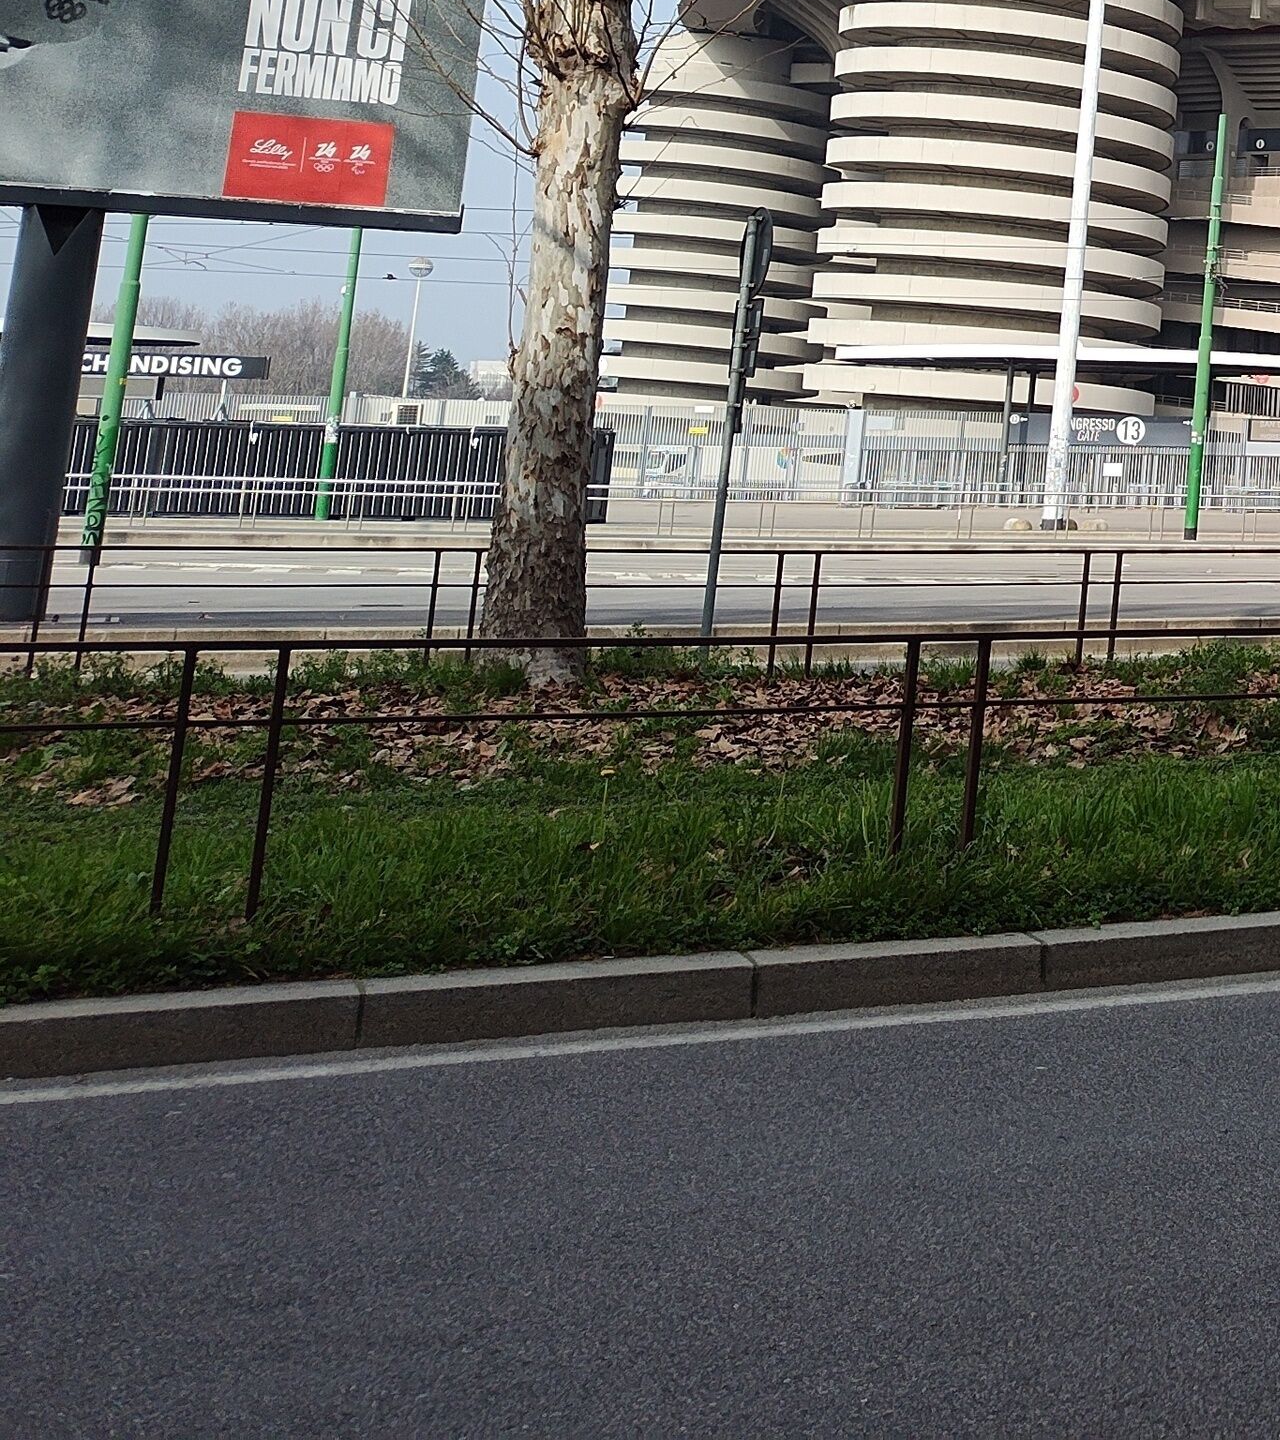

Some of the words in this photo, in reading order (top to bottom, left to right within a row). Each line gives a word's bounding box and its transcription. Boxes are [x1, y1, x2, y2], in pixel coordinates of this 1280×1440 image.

[238, 47, 403, 105] FERMIAMO
[250, 139, 293, 160] Lilly
[81, 354, 243, 376] CHNDISING
[1071, 417, 1116, 431] NGRESSO
[1121, 420, 1141, 441] 13
[1077, 430, 1100, 442] GATE
